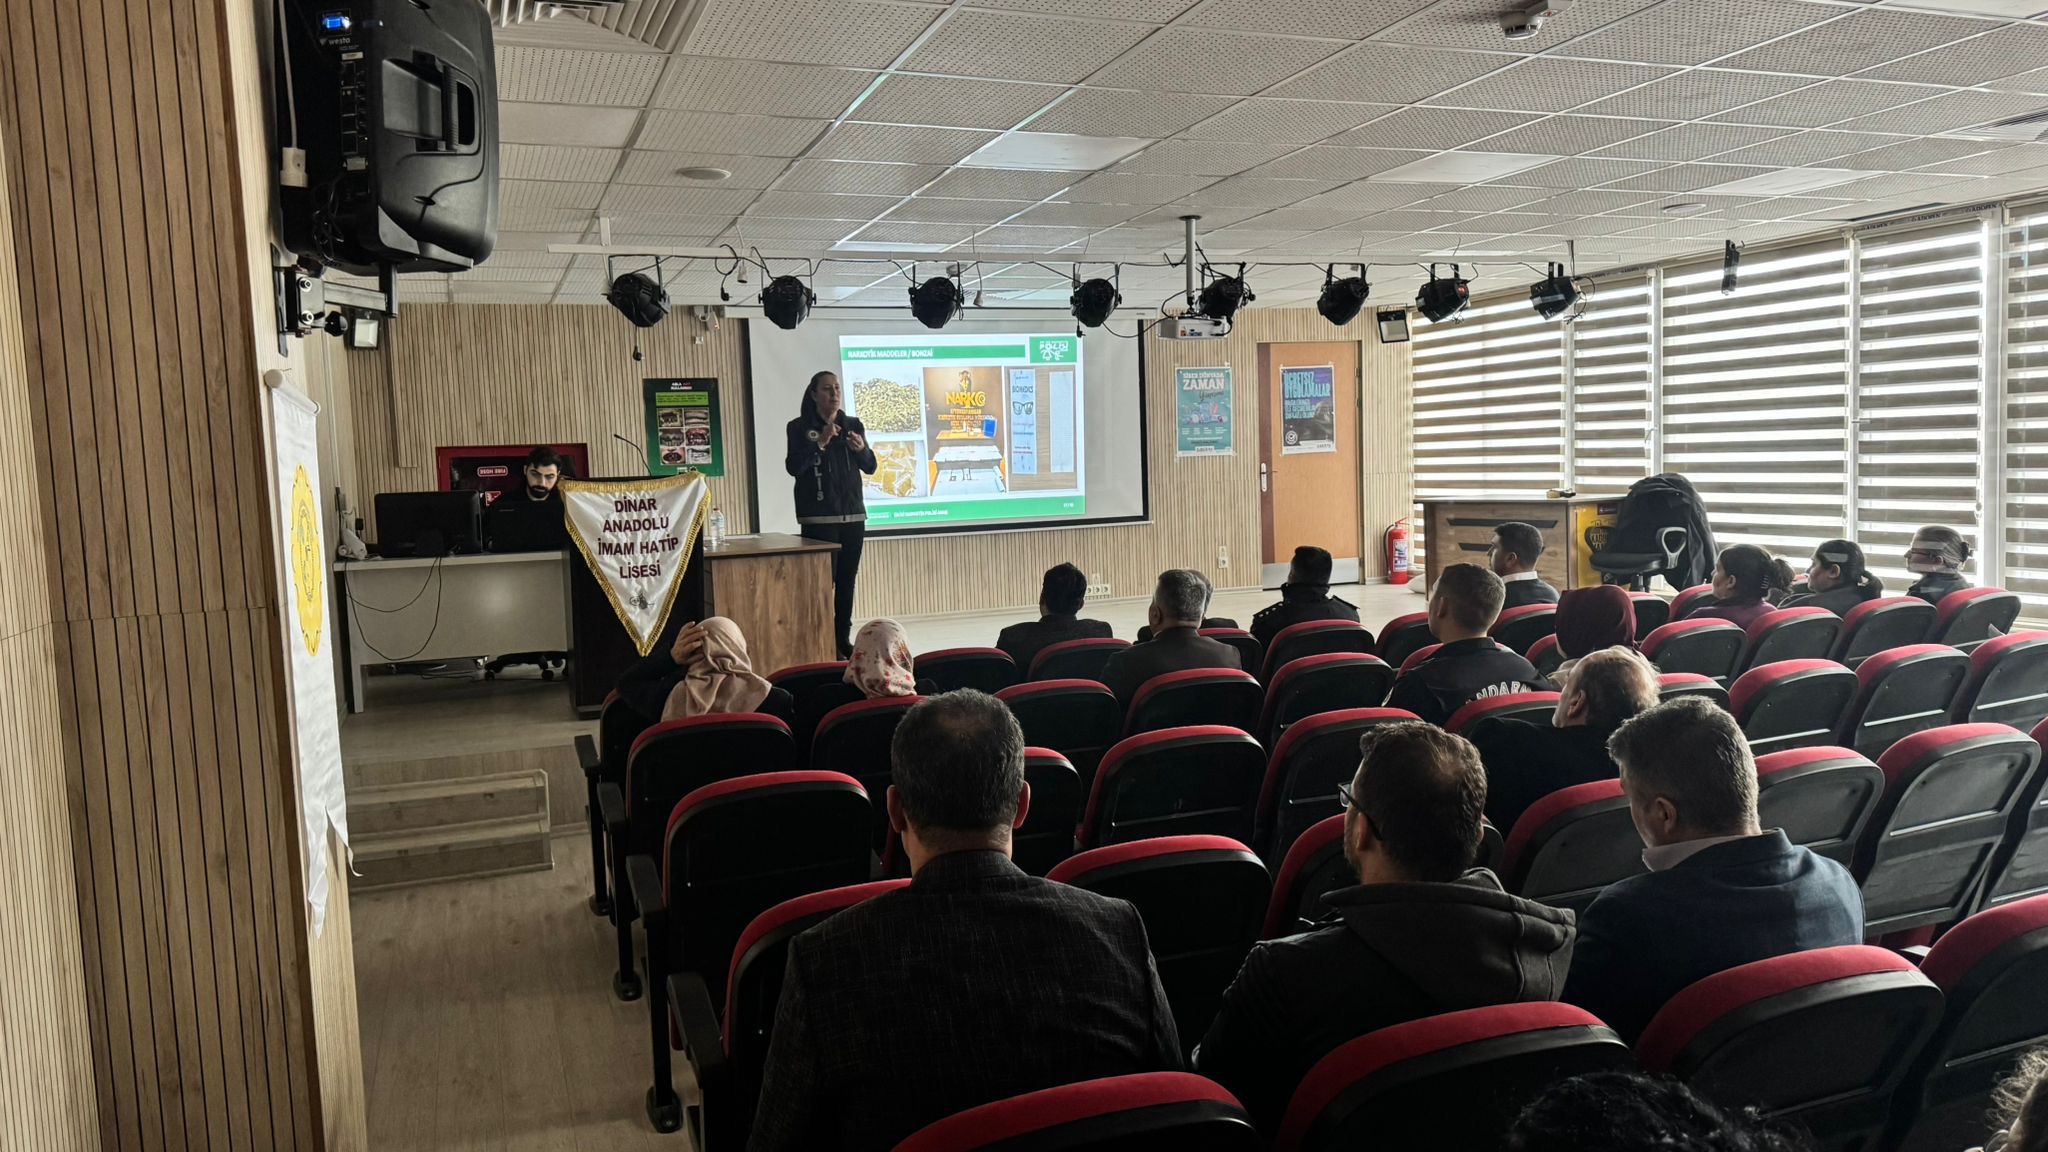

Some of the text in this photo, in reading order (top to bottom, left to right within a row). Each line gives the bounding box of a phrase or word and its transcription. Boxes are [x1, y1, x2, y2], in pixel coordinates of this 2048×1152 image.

[1183, 379, 1225, 391] ZAMAN
[614, 496, 658, 513] DİNAR
[602, 516, 669, 533] ANADOLU
[598, 533, 679, 556] İMAM HATİP
[619, 560, 661, 579] LİSESİ
